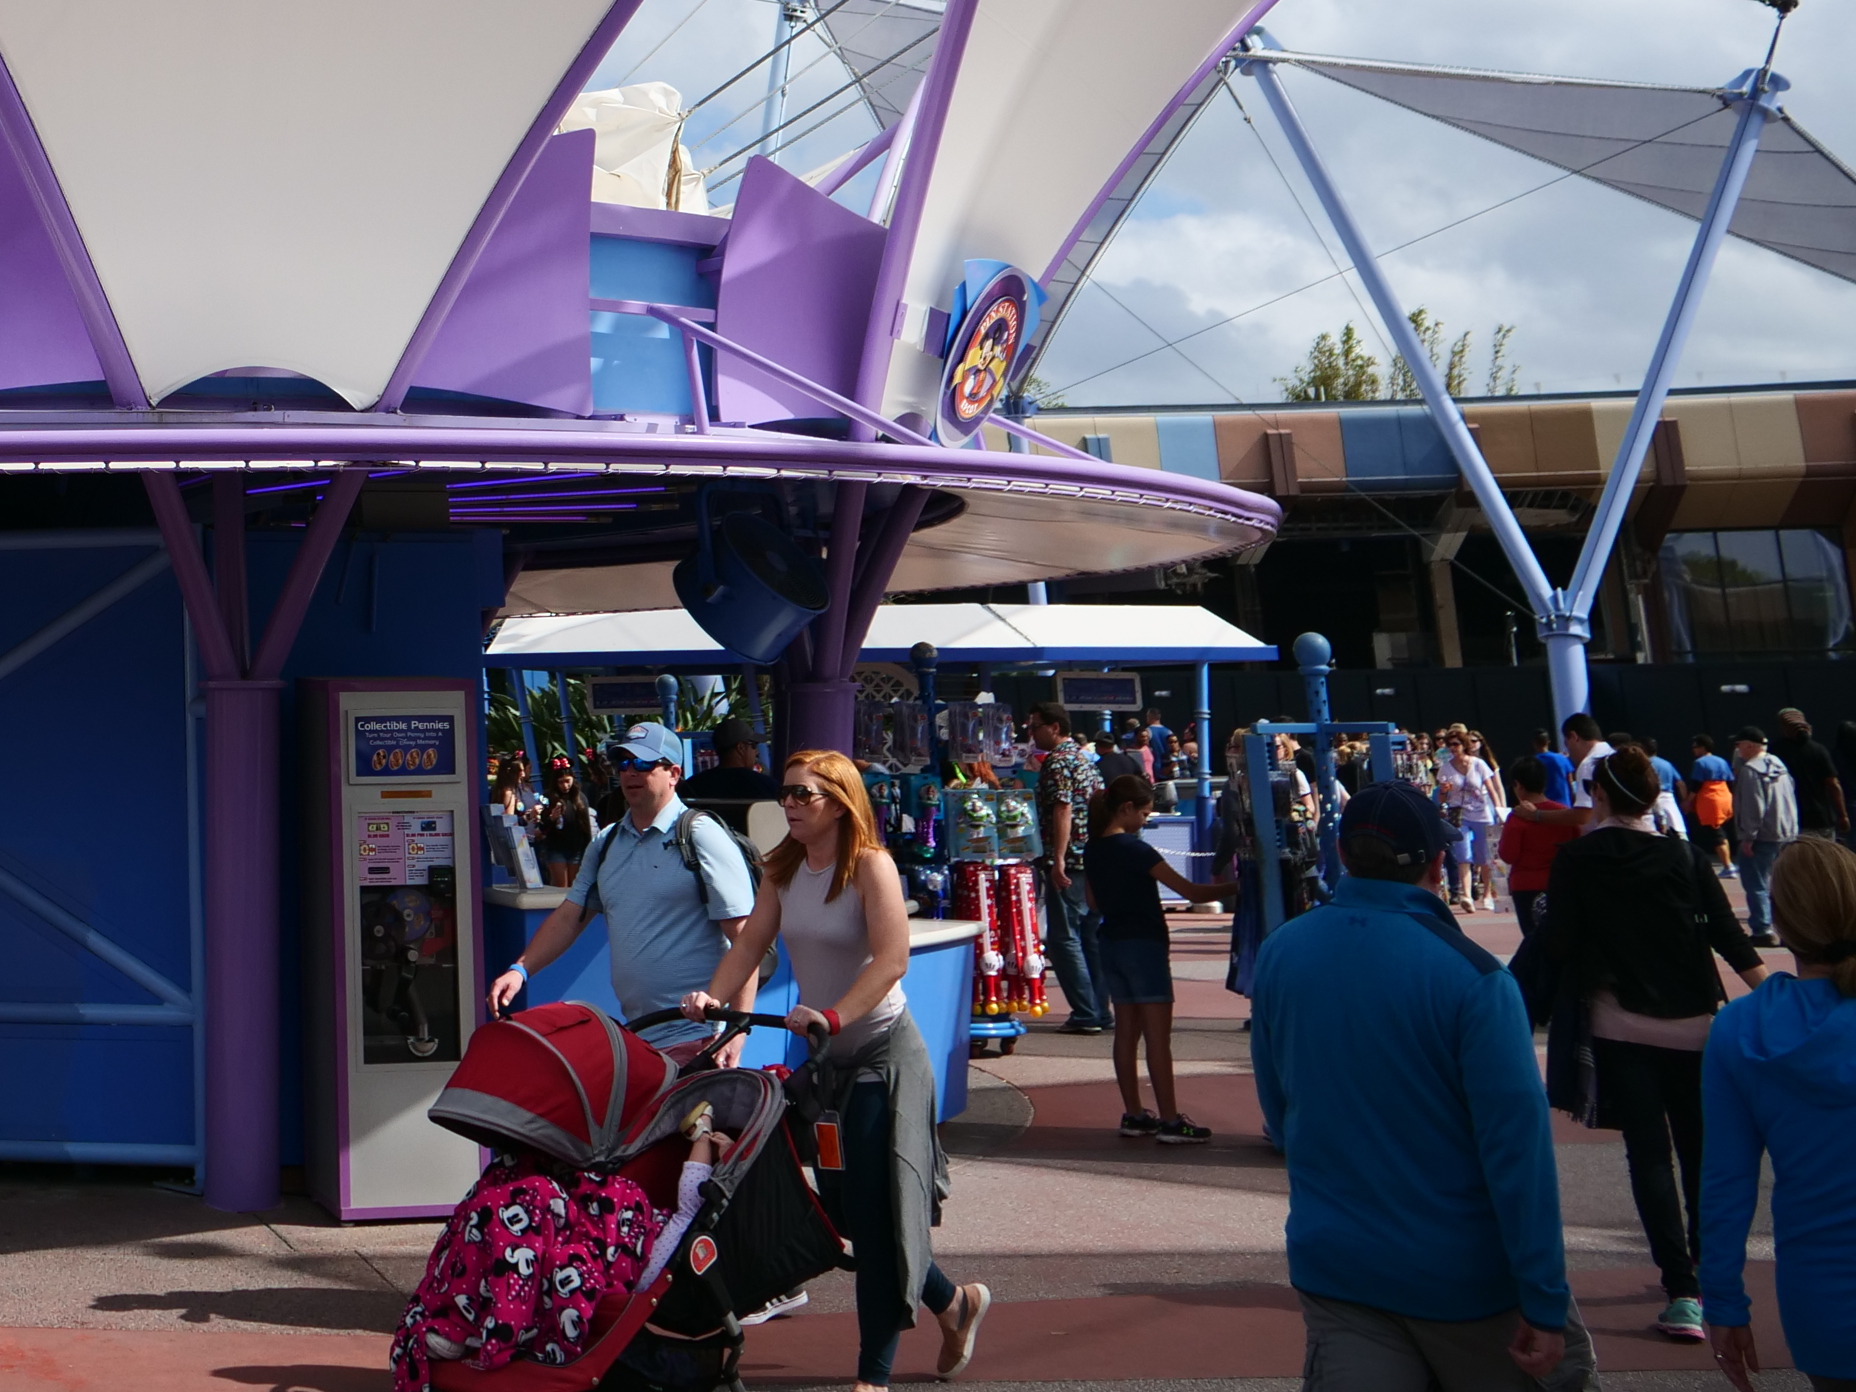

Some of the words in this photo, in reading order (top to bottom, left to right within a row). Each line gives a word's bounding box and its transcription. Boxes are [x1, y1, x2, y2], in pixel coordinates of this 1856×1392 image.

[961, 399, 978, 414] EPCOT
[357, 721, 408, 730] Collectible
[411, 720, 450, 730] Pennies
